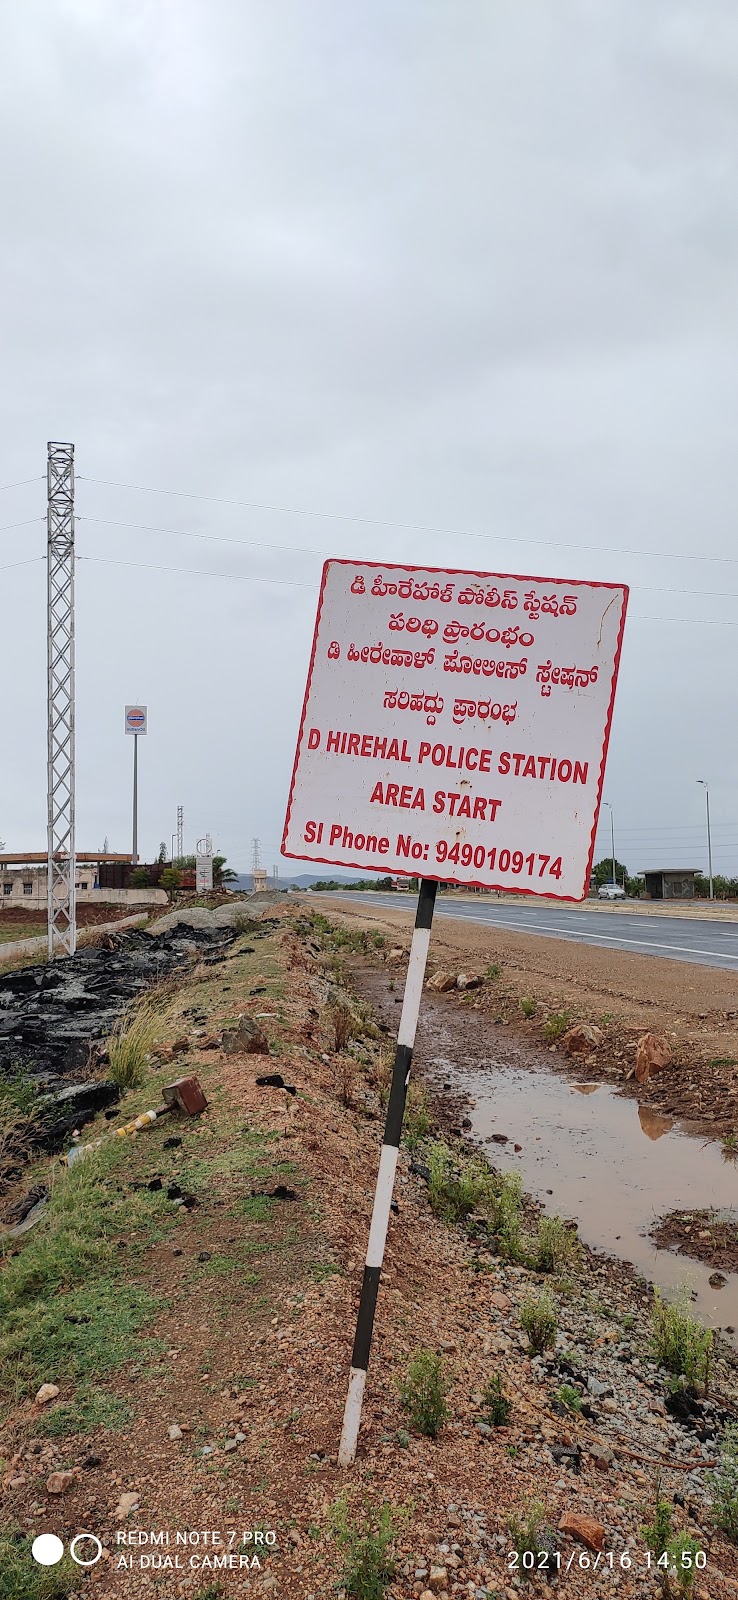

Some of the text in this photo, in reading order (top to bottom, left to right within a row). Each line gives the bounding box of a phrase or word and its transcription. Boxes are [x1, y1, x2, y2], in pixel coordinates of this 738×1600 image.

[350, 575, 366, 595] డి
[457, 587, 518, 610] పోలీస్
[523, 590, 578, 620] స్టేషన్
[388, 612, 535, 648] పరిధి ప్రారంభం
[327, 640, 340, 659] ಡಿ
[347, 641, 435, 669] ಹೀರೇಹಾಳ್
[536, 660, 599, 697] ಸ್ಟೇಷನ್
[383, 688, 518, 726] ಸರಿಹದ್ದು ಪ್ರಾರಂಭ
[308, 728, 589, 784] D HIREHAL POLICE STATION
[370, 781, 502, 822] AREA START
[304, 821, 563, 880] SI Phone No: 9490109174
